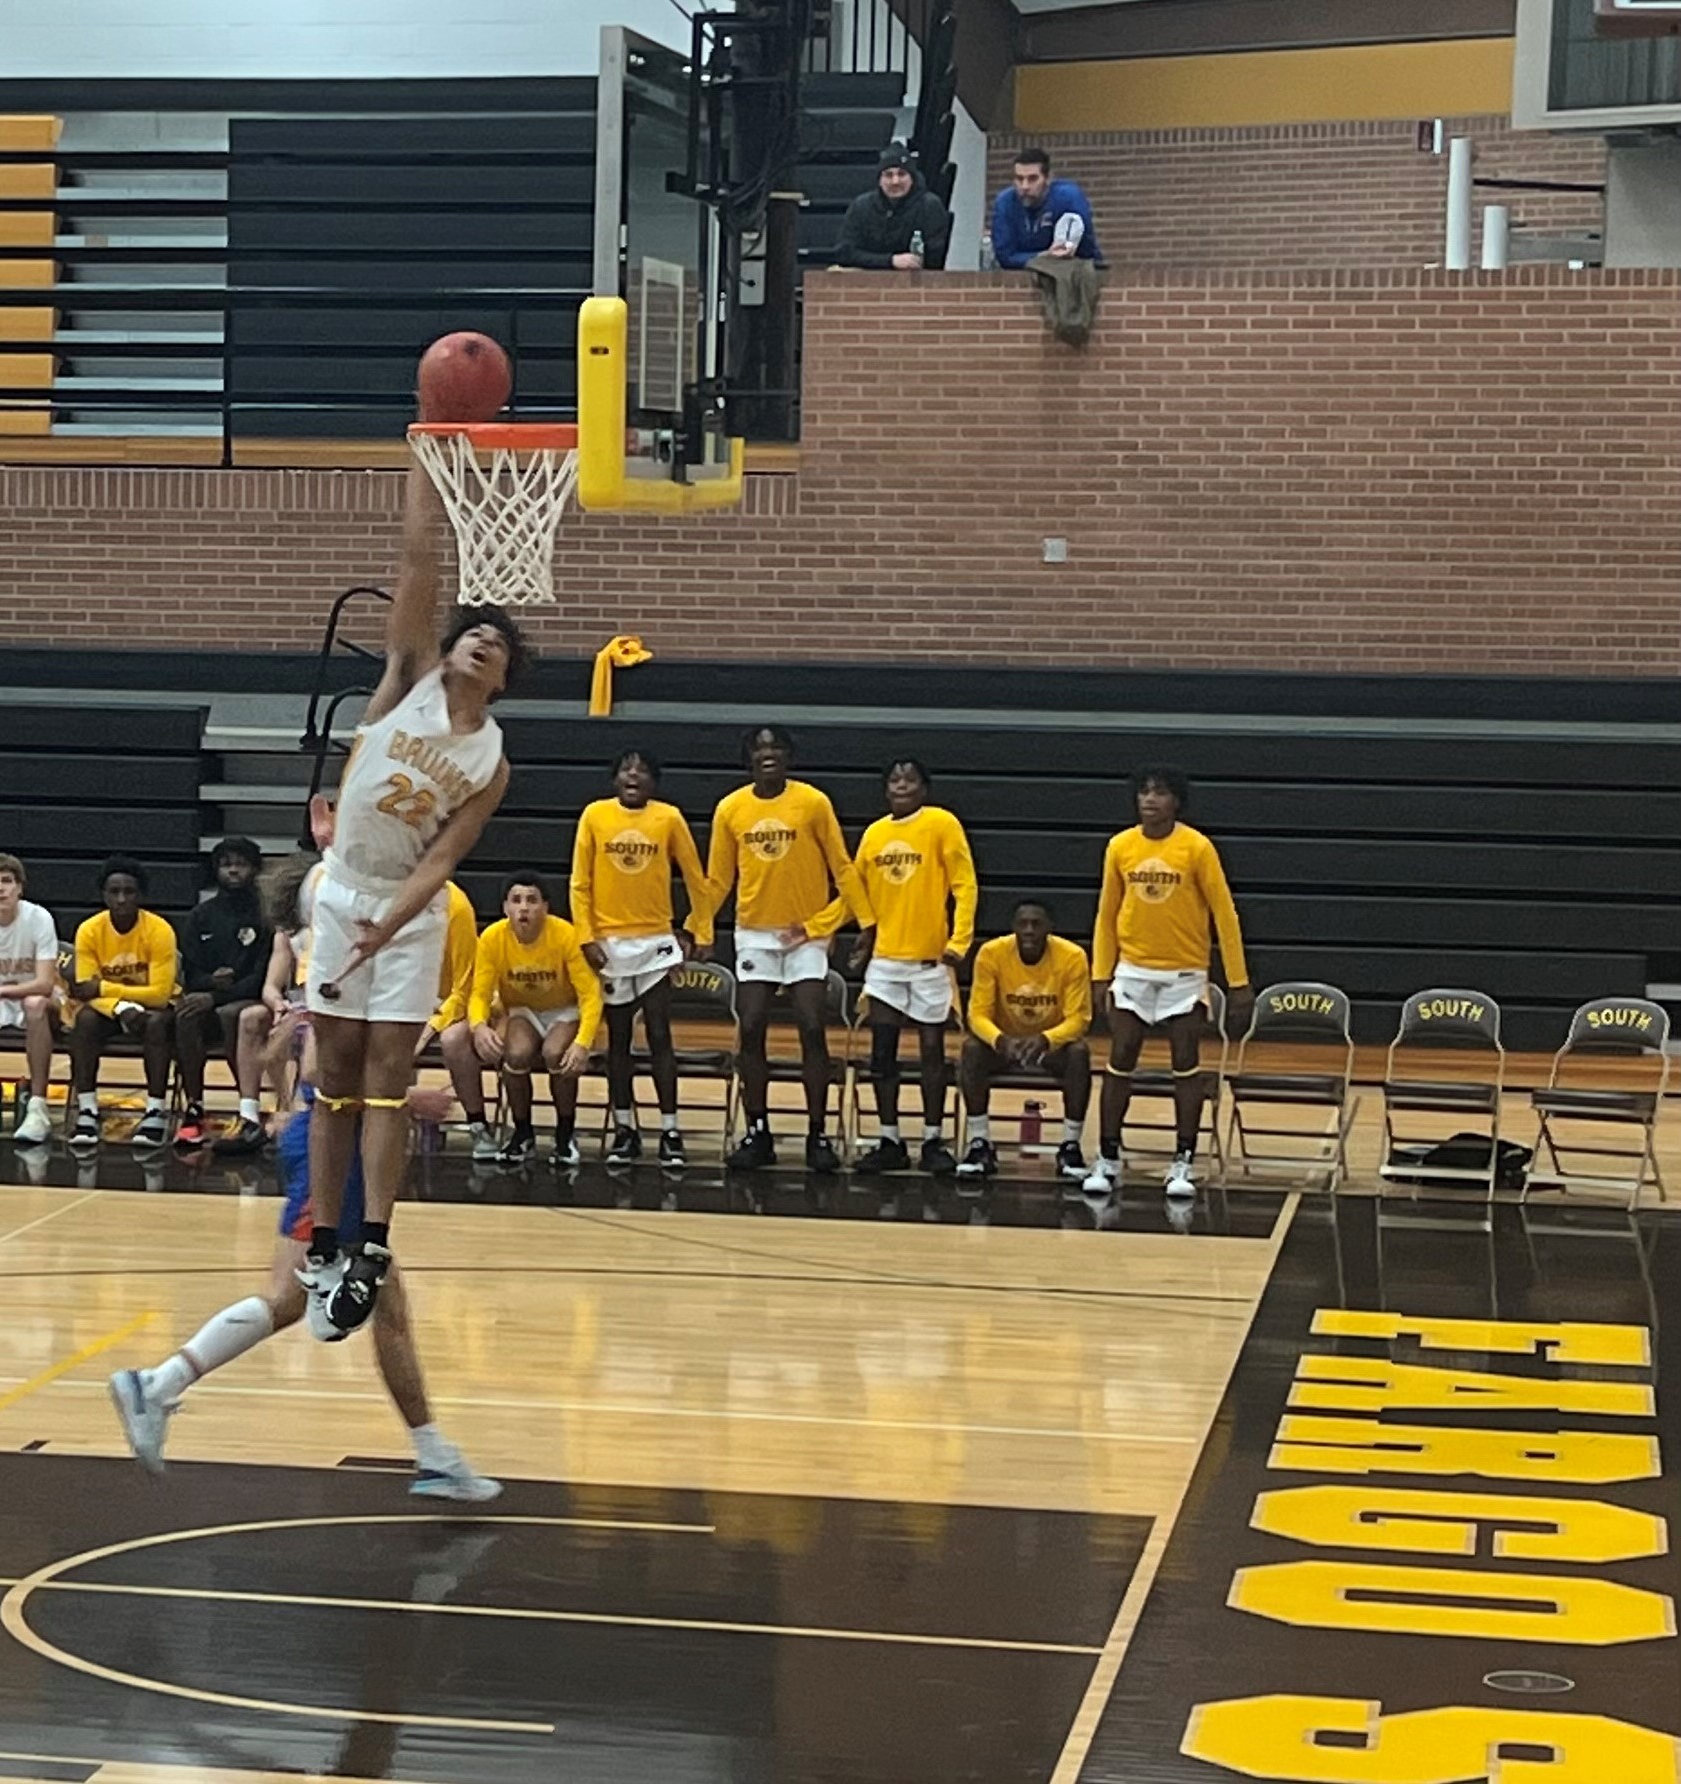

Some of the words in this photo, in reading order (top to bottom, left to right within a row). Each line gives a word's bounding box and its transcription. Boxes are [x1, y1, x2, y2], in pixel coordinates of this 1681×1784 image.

[376, 772, 436, 830] 22
[744, 829, 798, 844] SOUTH
[604, 842, 659, 856] SOUTH
[875, 853, 923, 867] SOUTH
[1127, 871, 1181, 885] SOUTH
[673, 969, 722, 992] OUTH
[1270, 992, 1334, 1015] SOUTH
[1418, 998, 1485, 1023] SOUTH
[1586, 1007, 1653, 1031] SOUTH
[1226, 1308, 1679, 1646] FARGO
